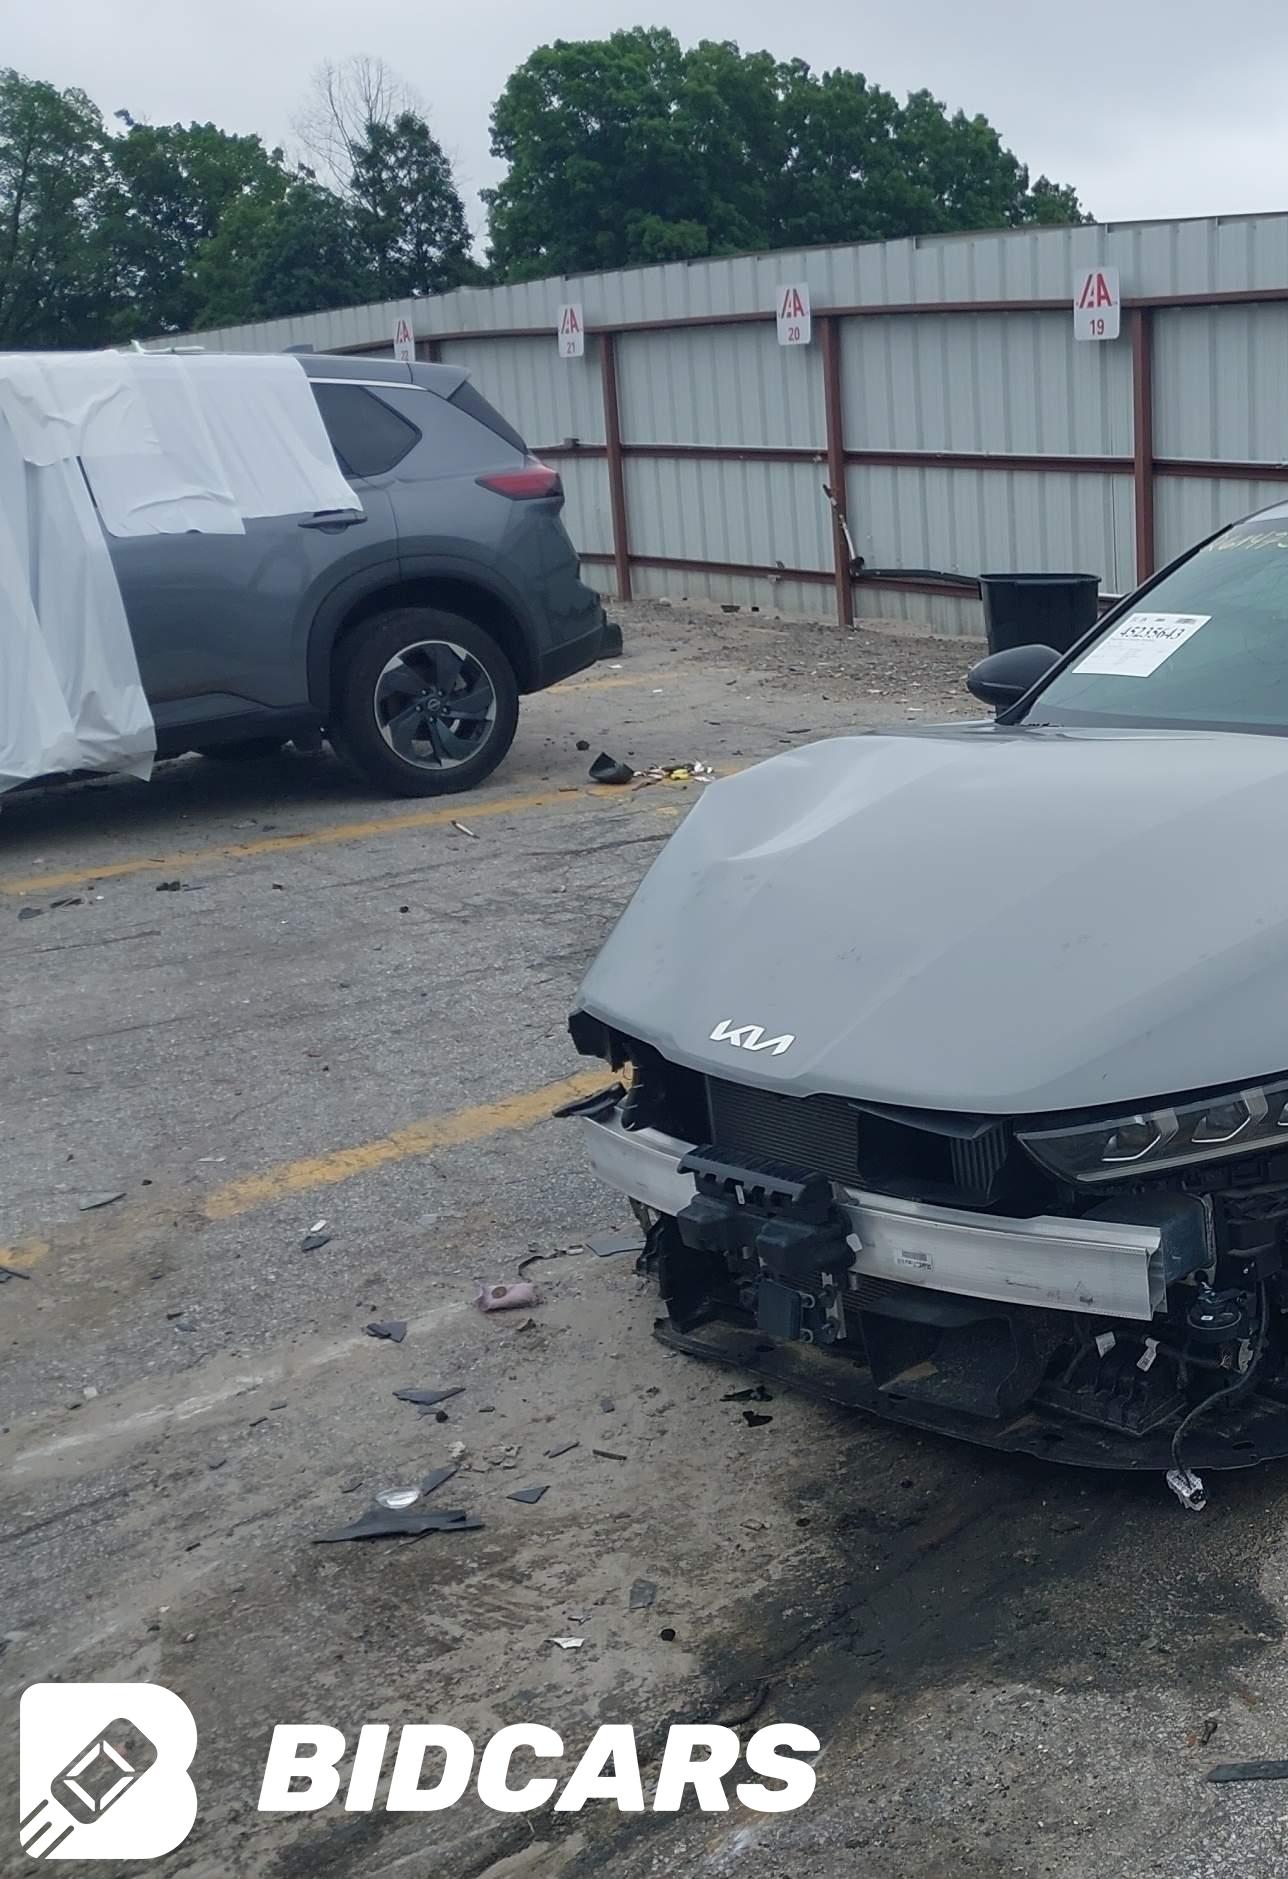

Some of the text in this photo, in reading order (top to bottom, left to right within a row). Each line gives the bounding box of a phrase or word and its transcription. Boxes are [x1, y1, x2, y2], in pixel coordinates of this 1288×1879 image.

[788, 327, 800, 341] 20
[1089, 319, 1105, 336] 19
[566, 342, 576, 354] 21
[709, 1019, 796, 1056] KIA
